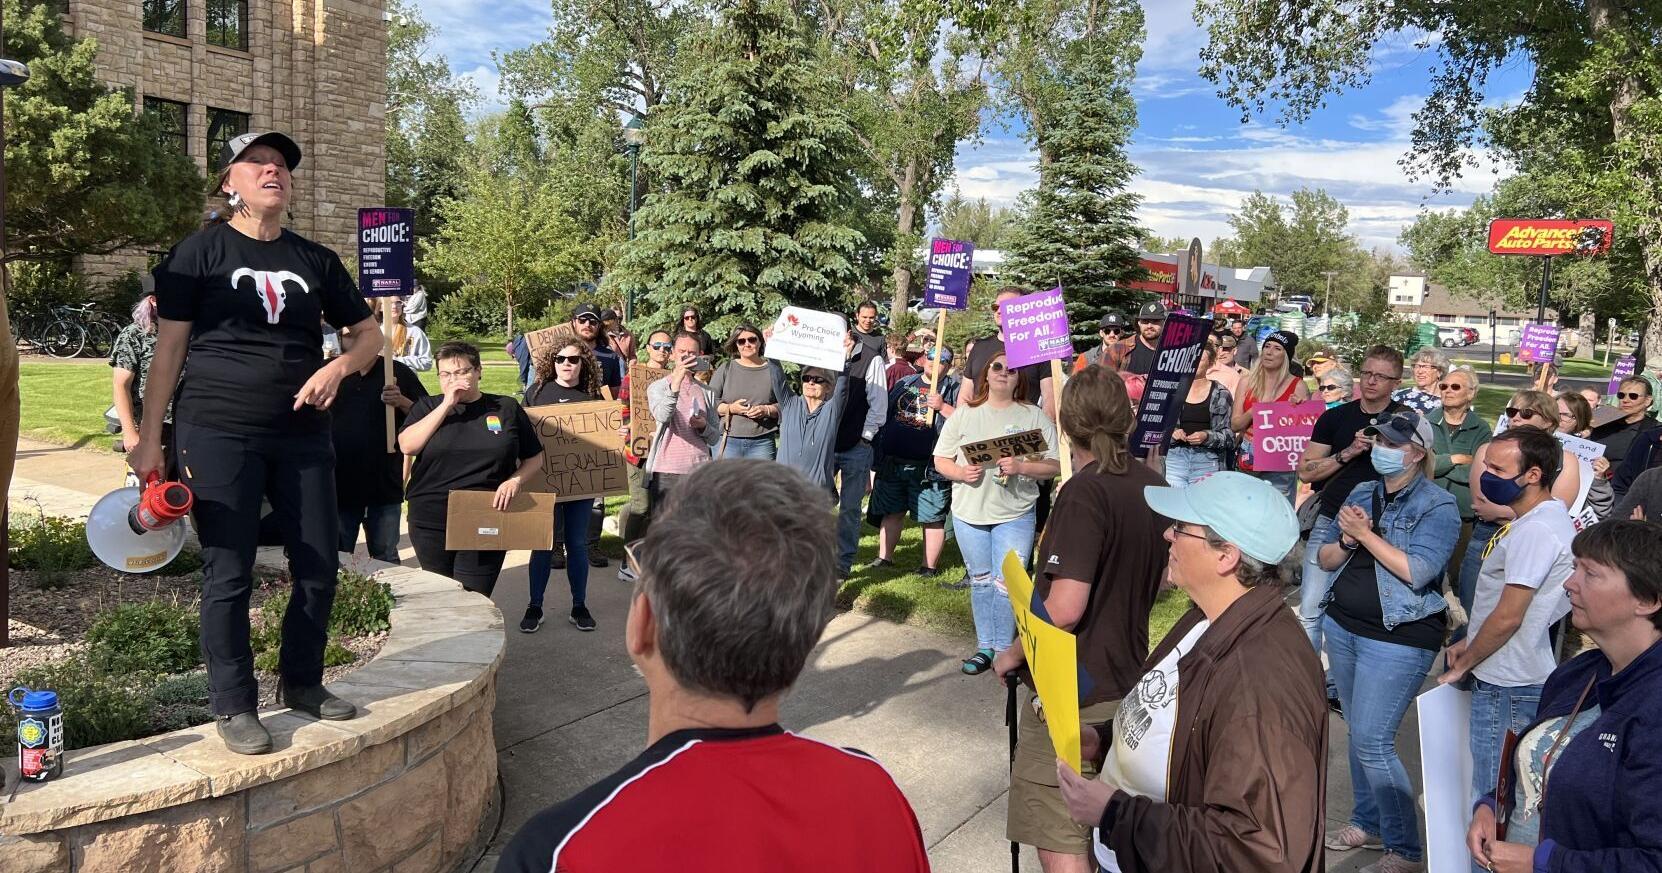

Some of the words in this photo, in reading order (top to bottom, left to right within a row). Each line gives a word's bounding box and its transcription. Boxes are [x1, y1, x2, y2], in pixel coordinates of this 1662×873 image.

[362, 212, 385, 228] MEN
[362, 222, 410, 243] CHOICE:
[1502, 226, 1577, 239] Advance
[933, 240, 951, 254] MEN
[1495, 238, 1532, 248] Auto
[932, 252, 970, 270] CHOICE:
[1007, 309, 1063, 329] Freedom
[791, 329, 825, 344] Wyoming
[802, 323, 841, 337] Pro-Choice
[1009, 331, 1030, 343] For
[1034, 324, 1055, 338] All.
[1163, 321, 1192, 346] MEN
[1149, 391, 1168, 400] FREEDOM
[1257, 410, 1274, 429] I
[965, 443, 988, 453] NO
[993, 432, 1040, 448] UTERUS
[1579, 444, 1597, 453] and
[970, 453, 993, 464] NO
[1000, 440, 1043, 458] SAY
[546, 467, 623, 494] STATE
